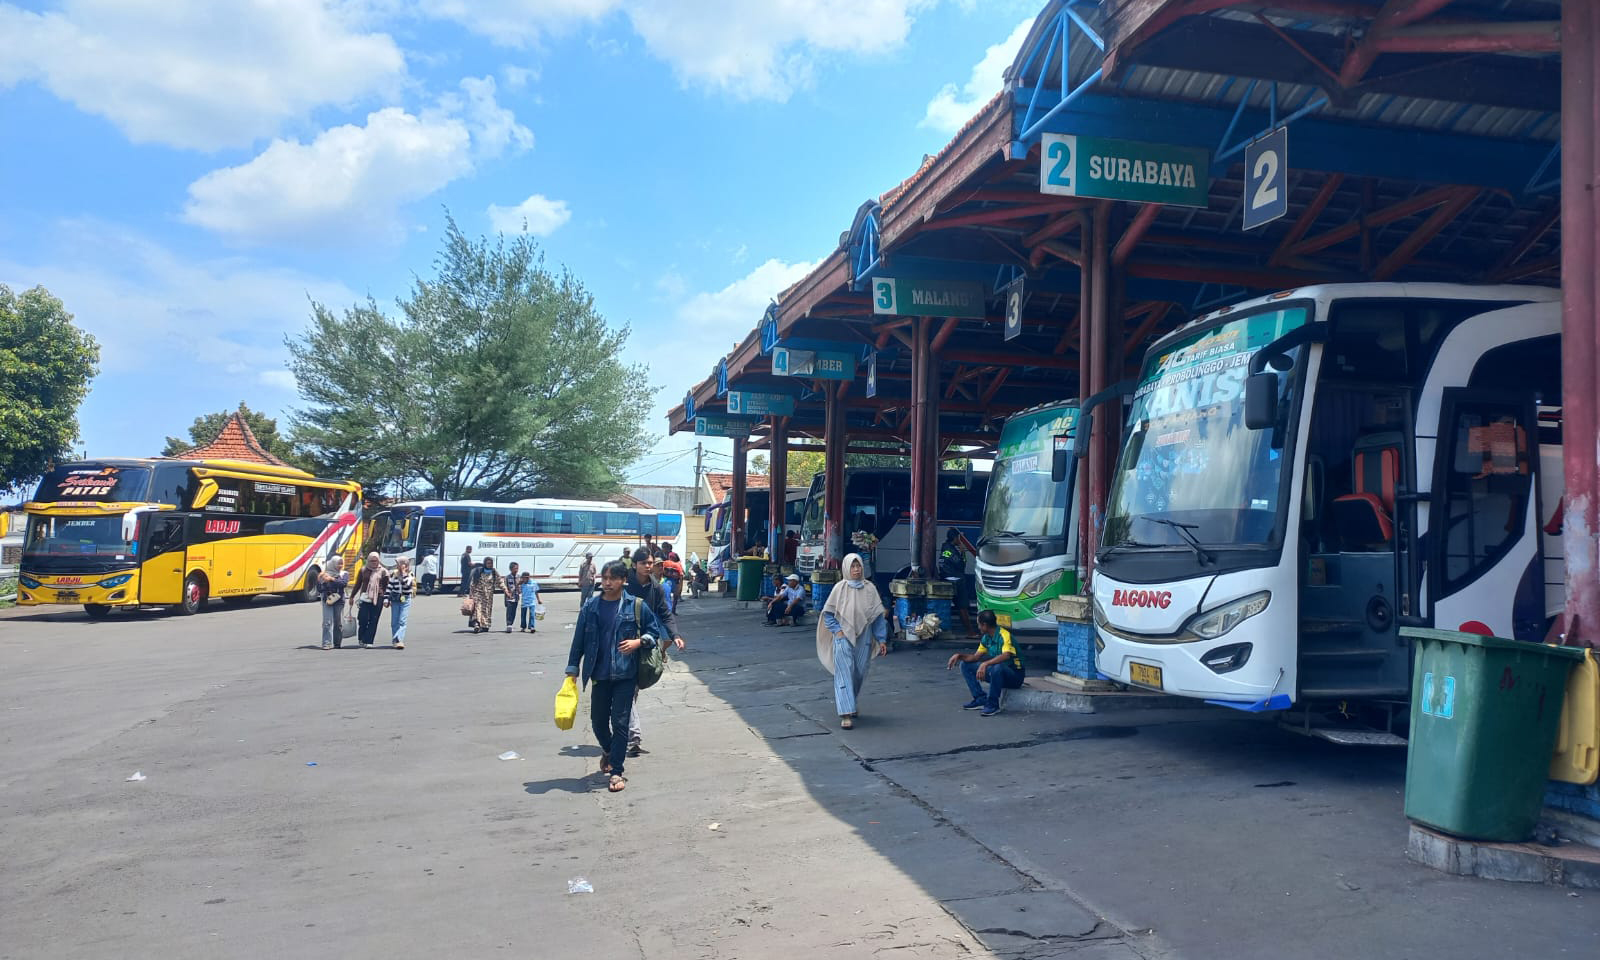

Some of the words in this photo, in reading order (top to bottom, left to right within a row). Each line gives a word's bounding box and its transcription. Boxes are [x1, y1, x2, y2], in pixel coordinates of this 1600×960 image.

[1047, 142, 1071, 187] 2
[1089, 154, 1196, 188] SURABAYA
[1252, 150, 1278, 210] 2
[876, 282, 893, 310] 3
[911, 289, 970, 308] MALANG
[1008, 292, 1020, 329] 3
[775, 351, 787, 372] 4
[1186, 351, 1207, 363] TARIF
[1209, 342, 1235, 356] BIASA
[868, 364, 875, 388] 4
[1168, 360, 1224, 385] PROBOLINGGO
[1230, 353, 1252, 368] JEM
[729, 394, 740, 411] 5
[696, 420, 705, 434] 6
[1053, 416, 1073, 429] AC
[61, 486, 111, 496] PATAS
[205, 519, 240, 534] LADJU
[1112, 589, 1172, 609] BAGONG
